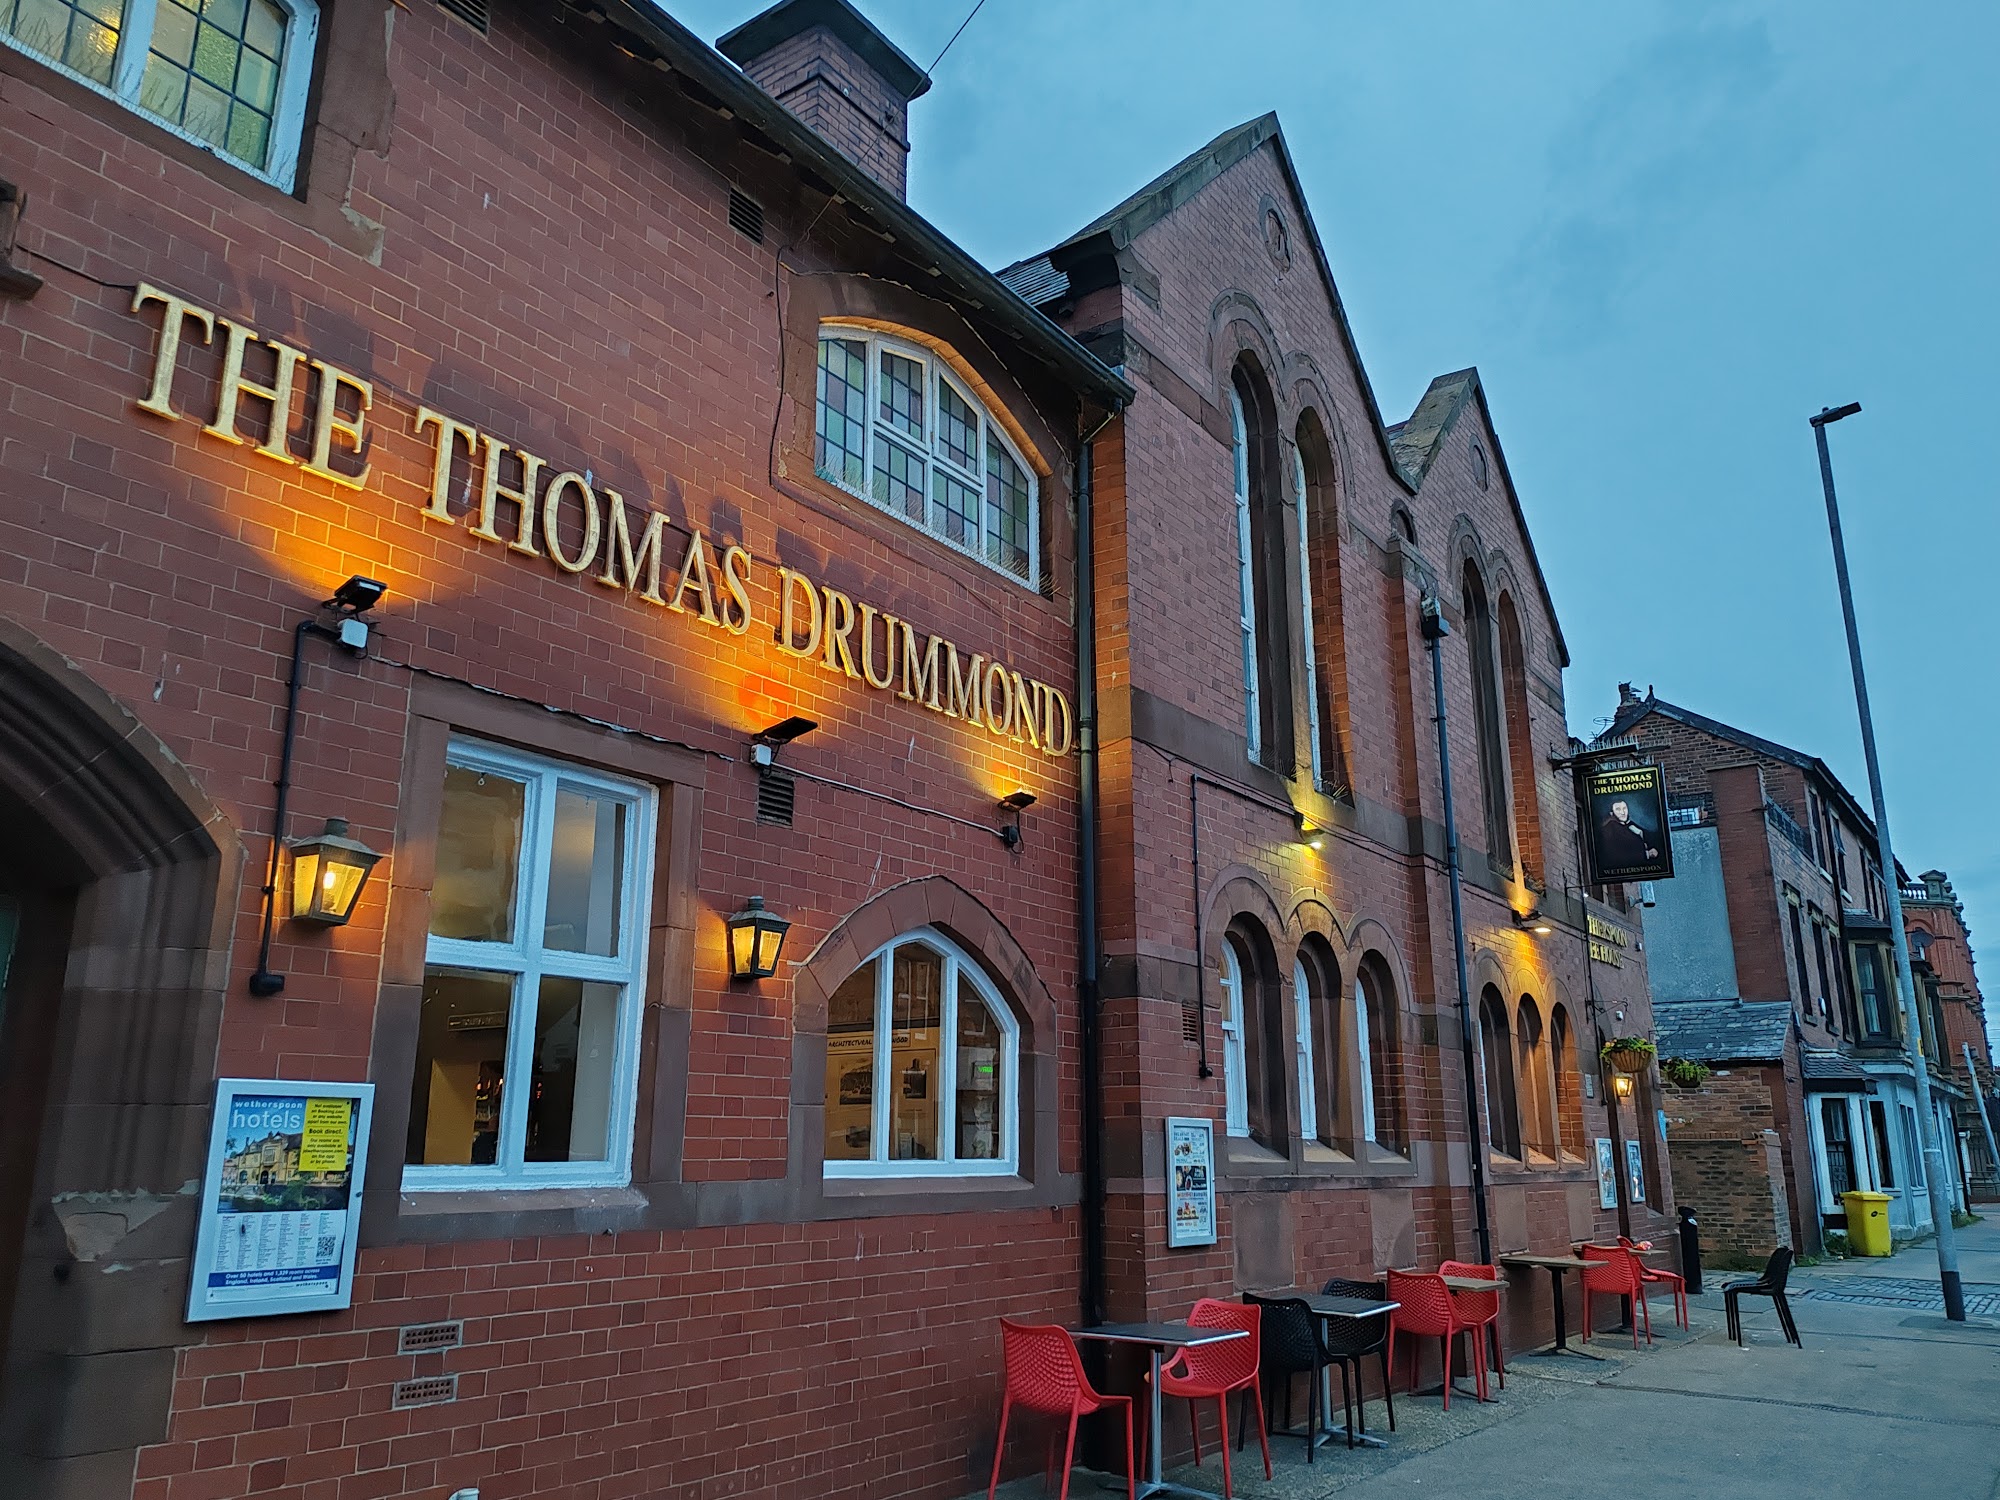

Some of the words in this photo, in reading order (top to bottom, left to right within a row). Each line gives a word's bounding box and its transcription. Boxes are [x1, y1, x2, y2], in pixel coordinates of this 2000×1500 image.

[130, 281, 373, 491] THE
[414, 405, 752, 635] THOMAS
[776, 567, 1076, 757] DRUMMOND
[1609, 773, 1652, 784] THOMAS
[1594, 781, 1653, 794] DRUMMOND
[1603, 865, 1662, 874] WETHERSPOON
[1587, 915, 1628, 948] THERSPOON
[1600, 945, 1624, 968] HOUSE
[828, 1039, 872, 1048] ARCHITECTURAL
[235, 1100, 303, 1109] wetherspoon
[233, 1109, 300, 1128] hotels
